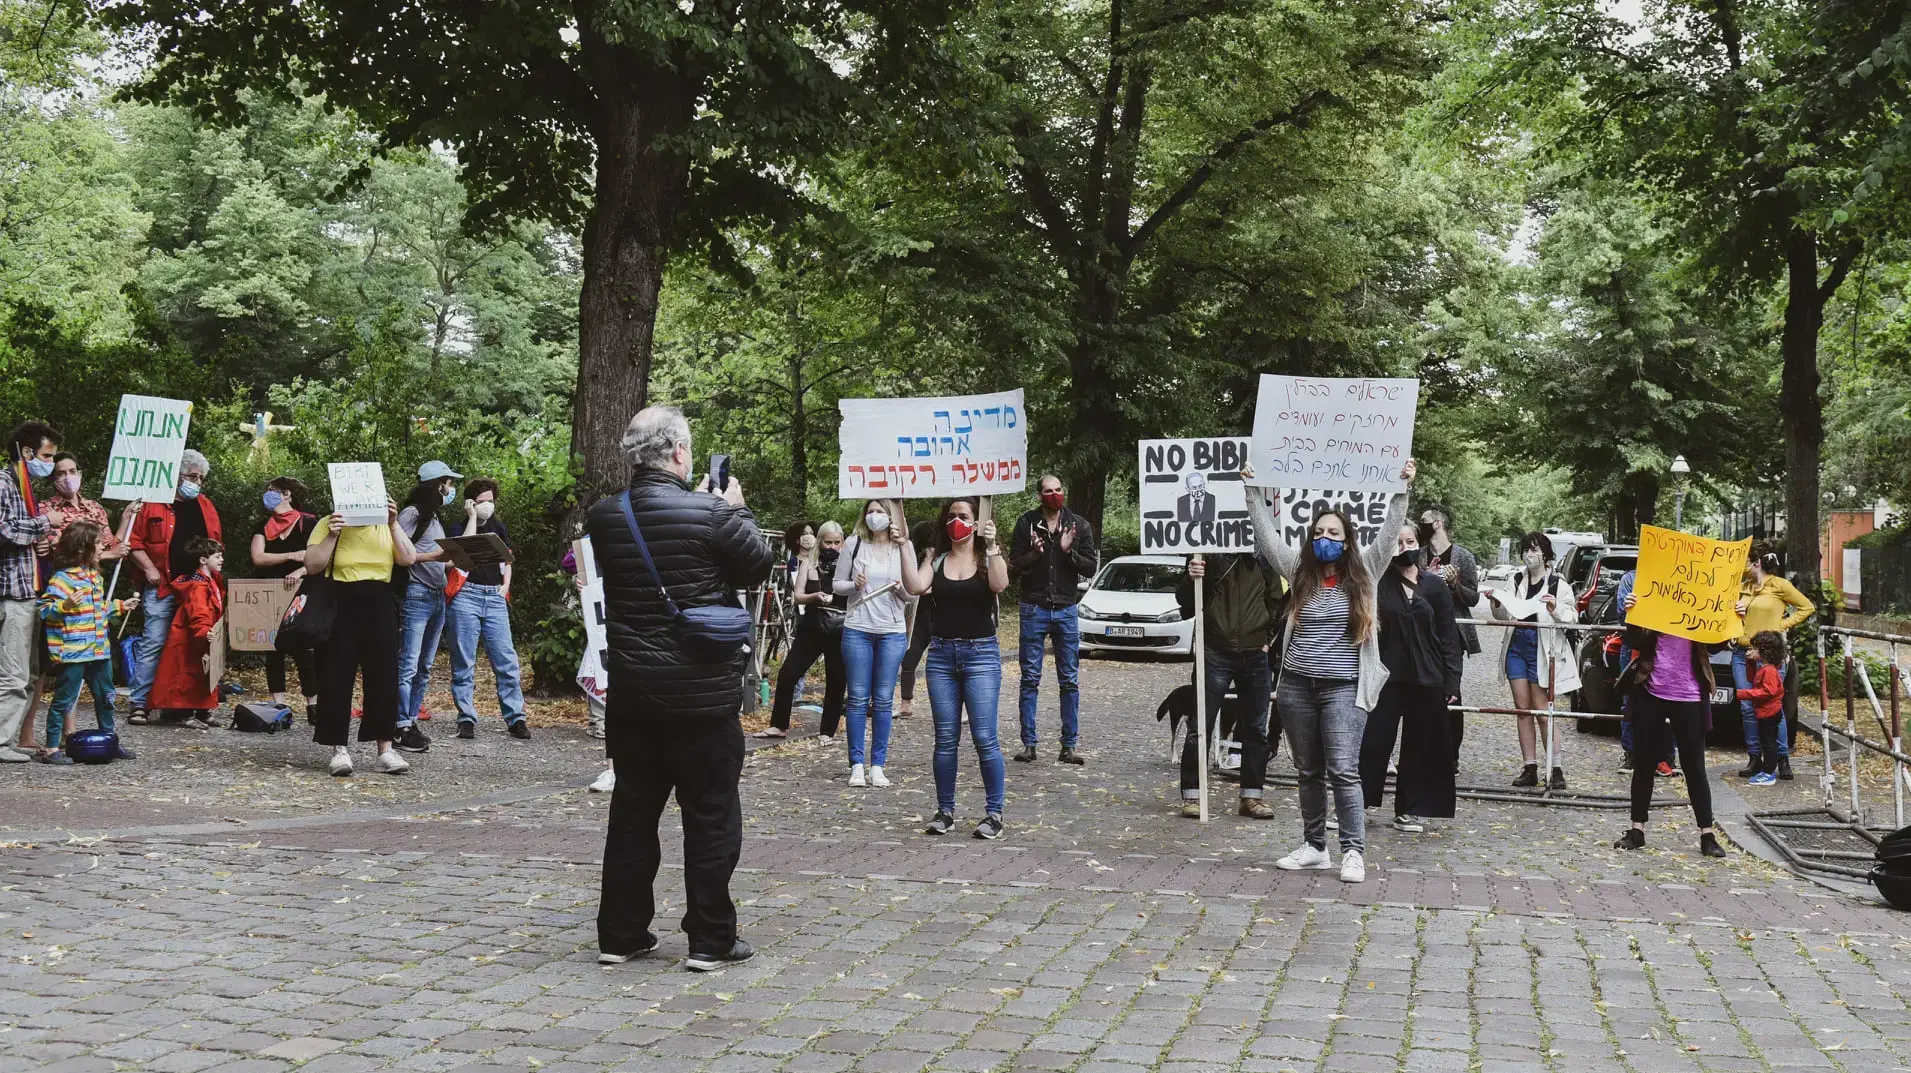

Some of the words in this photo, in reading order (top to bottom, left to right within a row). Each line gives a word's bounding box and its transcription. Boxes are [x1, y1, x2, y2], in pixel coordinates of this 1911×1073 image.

[1285, 378, 1331, 409] בברלין
[119, 408, 184, 439] אנחנו
[933, 404, 1017, 434] מדינה
[1275, 411, 1326, 427] ועומדים
[1332, 412, 1399, 434] מחזקים
[897, 433, 971, 458] אהובה
[1270, 436, 1316, 452] בבית
[1324, 438, 1374, 454] המוחים
[1380, 444, 1399, 458] עם
[1146, 444, 1186, 473] NO
[1193, 440, 1248, 471] BIBI
[1271, 451, 1304, 473] בלב
[108, 456, 174, 488] אתכם
[848, 465, 936, 494] רקובה
[952, 456, 1021, 484] ממשלה
[1311, 458, 1350, 481] אתכם
[1357, 463, 1397, 484] אנחנו
[1145, 520, 1181, 548] NO
[1185, 520, 1255, 547] CRIME
[234, 590, 274, 605] LAST
[1697, 594, 1724, 613] את
